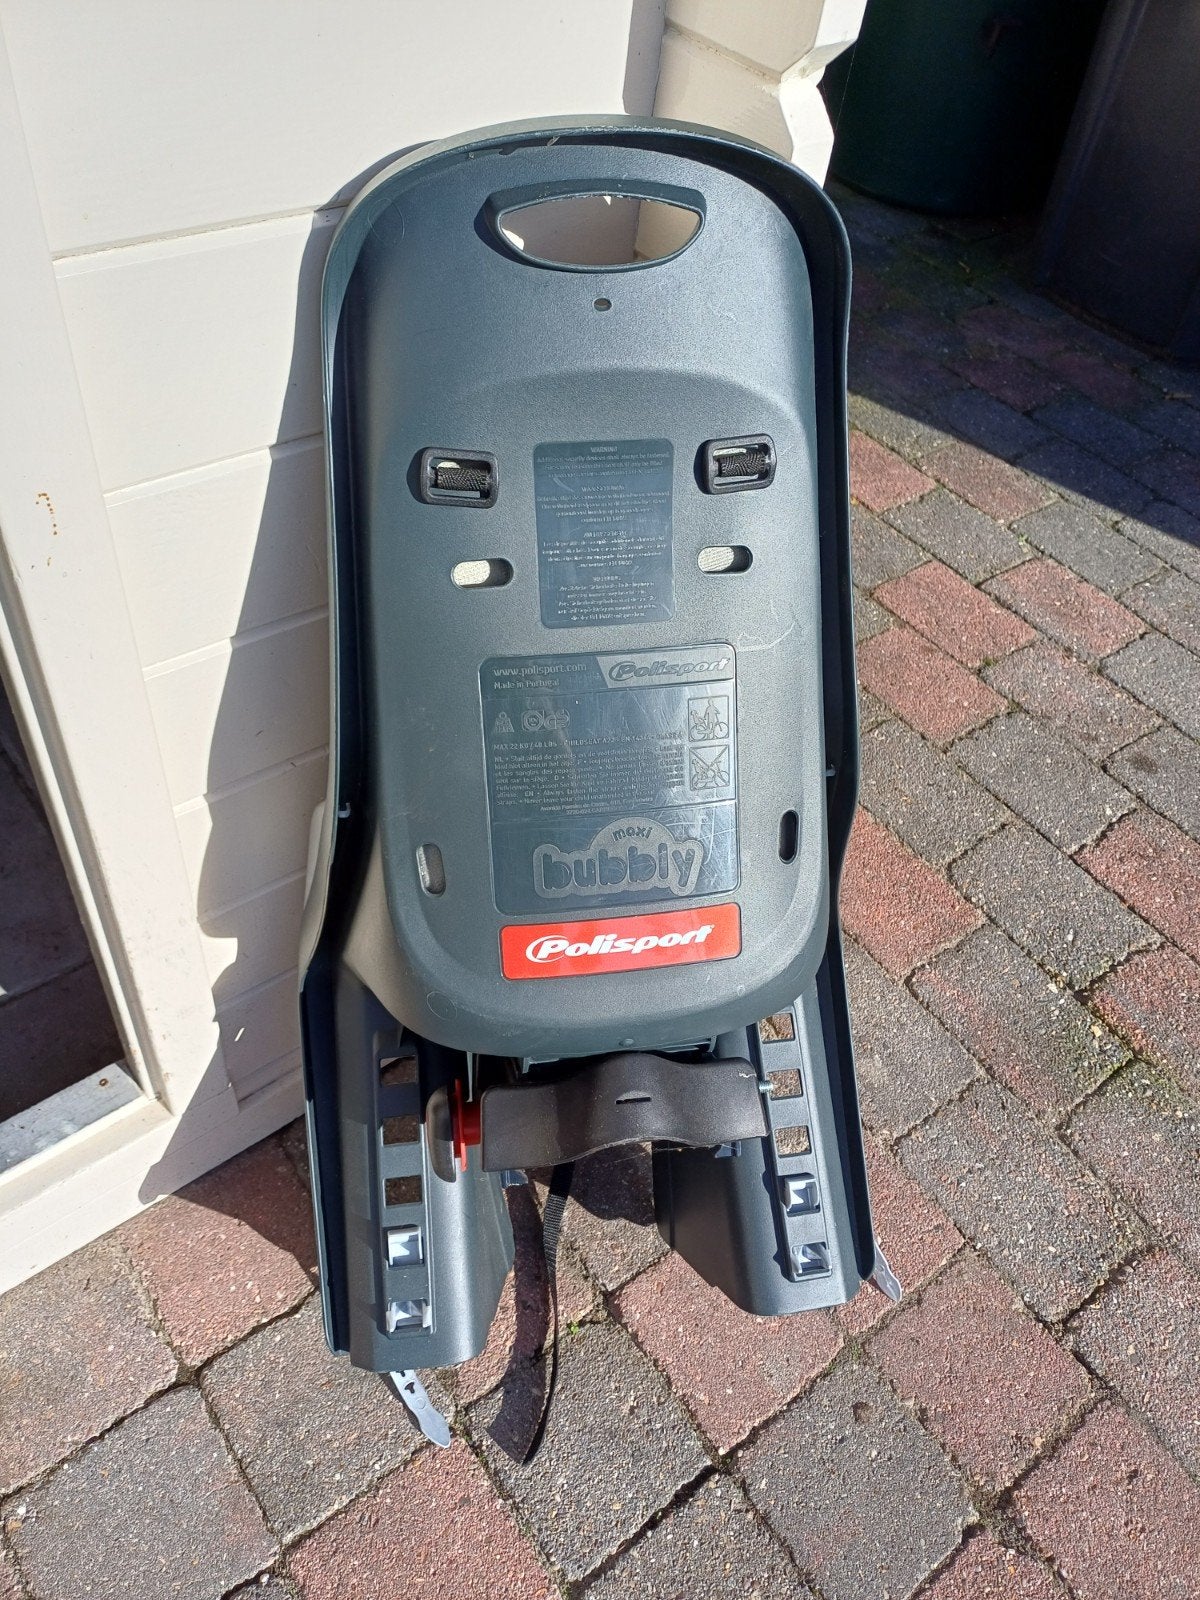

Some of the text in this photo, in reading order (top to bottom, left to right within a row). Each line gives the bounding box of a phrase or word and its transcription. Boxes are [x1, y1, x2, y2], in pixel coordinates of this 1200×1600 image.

[493, 664, 587, 677] www.polisport.com
[609, 657, 730, 682] Polisport
[494, 679, 560, 690] Made in Portugal
[494, 743, 509, 751] MAX
[510, 743, 518, 751] 22
[612, 825, 653, 842] maxi
[541, 842, 697, 891] bubbly
[525, 924, 715, 964] Polisport
